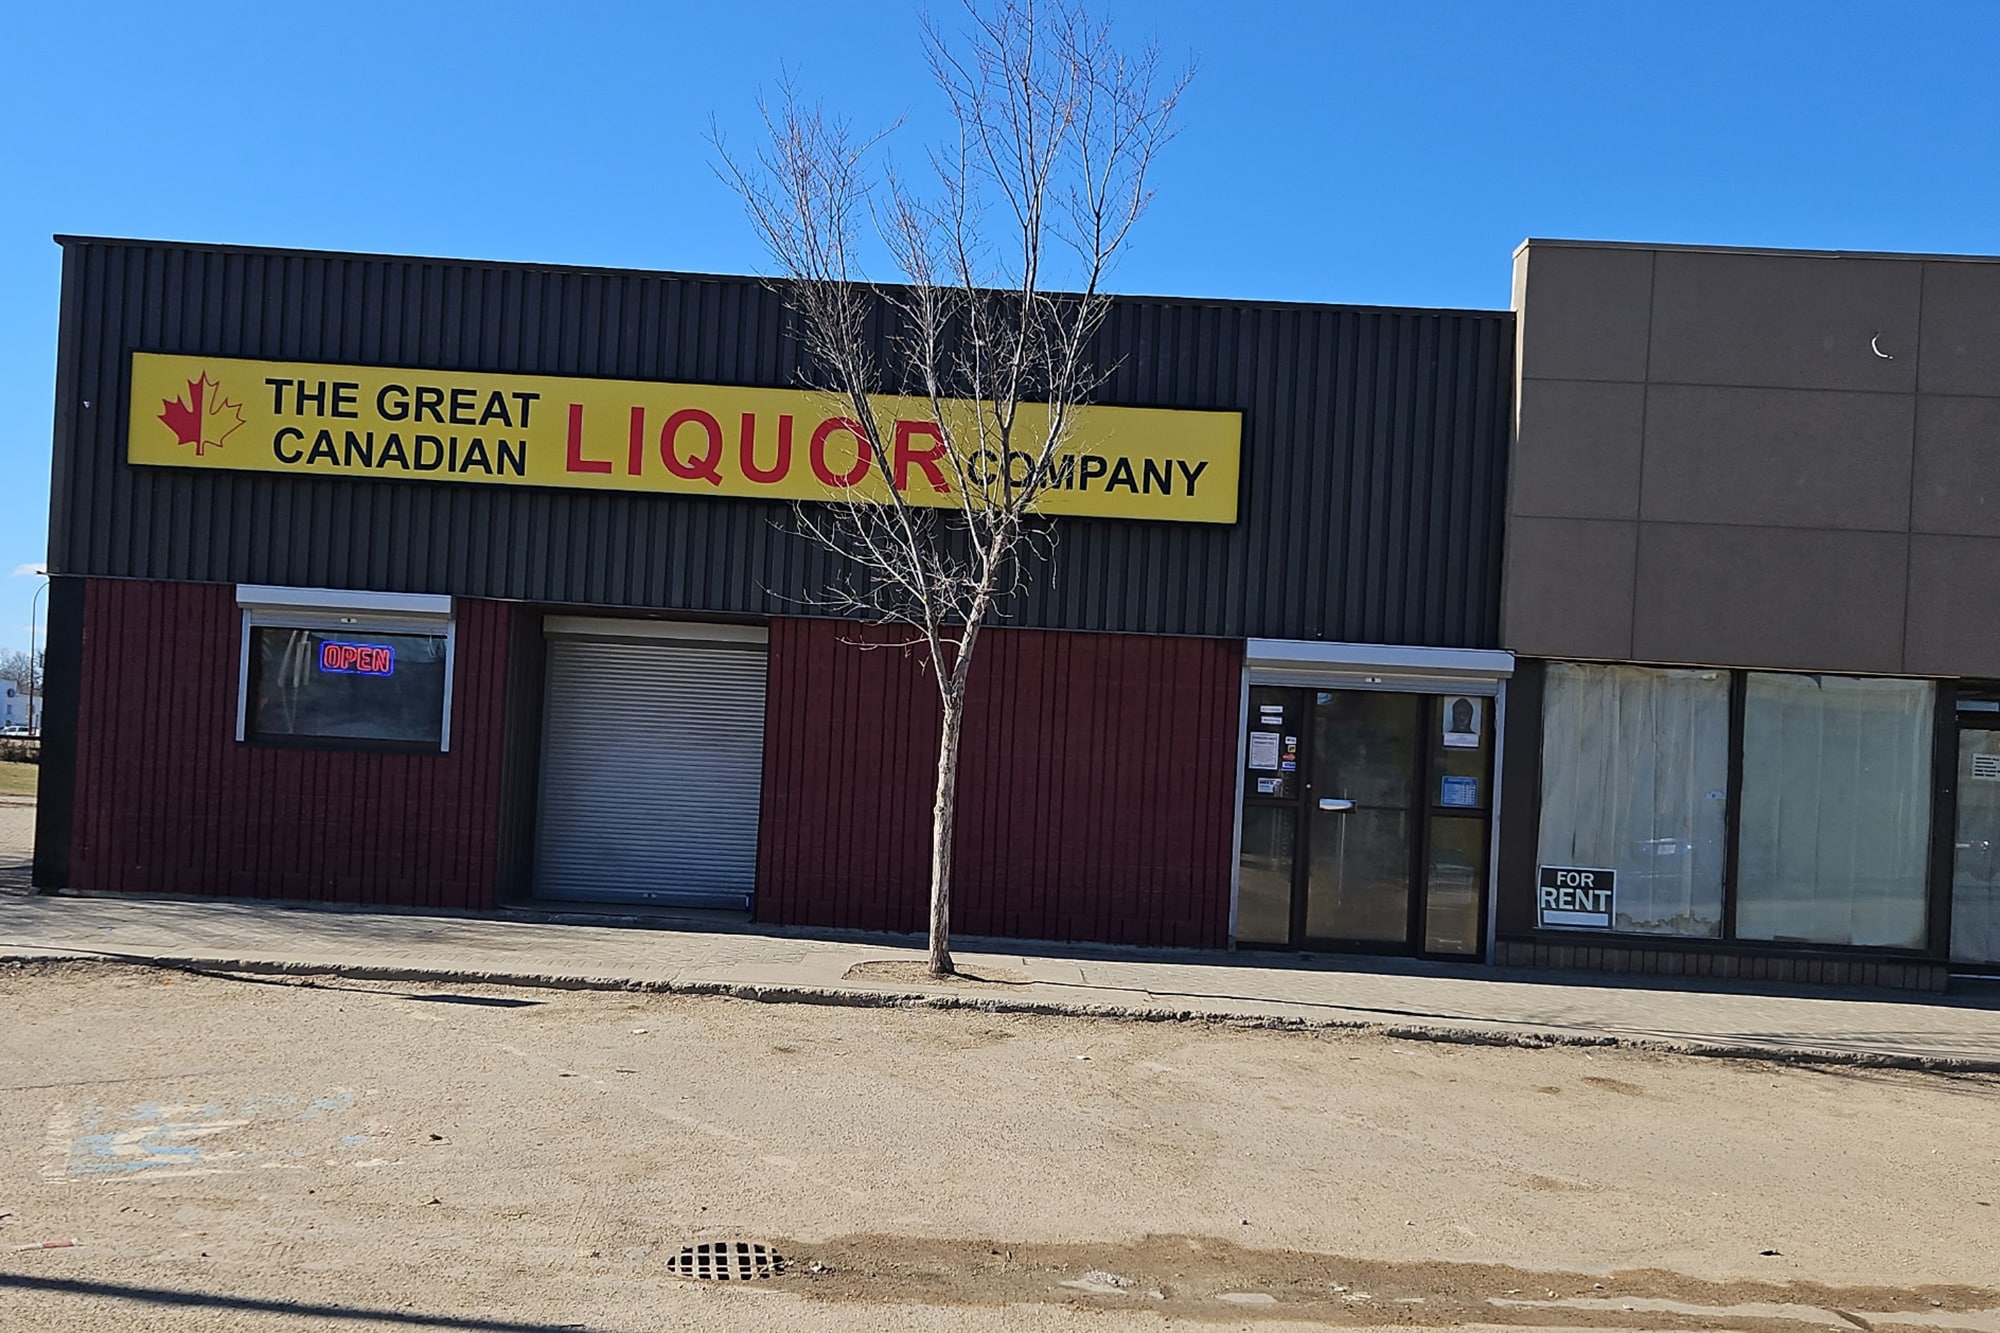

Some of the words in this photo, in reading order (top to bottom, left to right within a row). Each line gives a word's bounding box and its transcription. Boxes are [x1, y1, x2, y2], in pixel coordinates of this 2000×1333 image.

[264, 377, 359, 419] THE
[375, 384, 541, 429] GREAT
[273, 426, 527, 477] CANADIAN
[566, 403, 951, 493] LIQUOR
[967, 449, 1209, 497] COMPANY
[324, 645, 390, 672] OPEN
[1540, 886, 1612, 911] RENT
[1556, 871, 1595, 887] FOR
